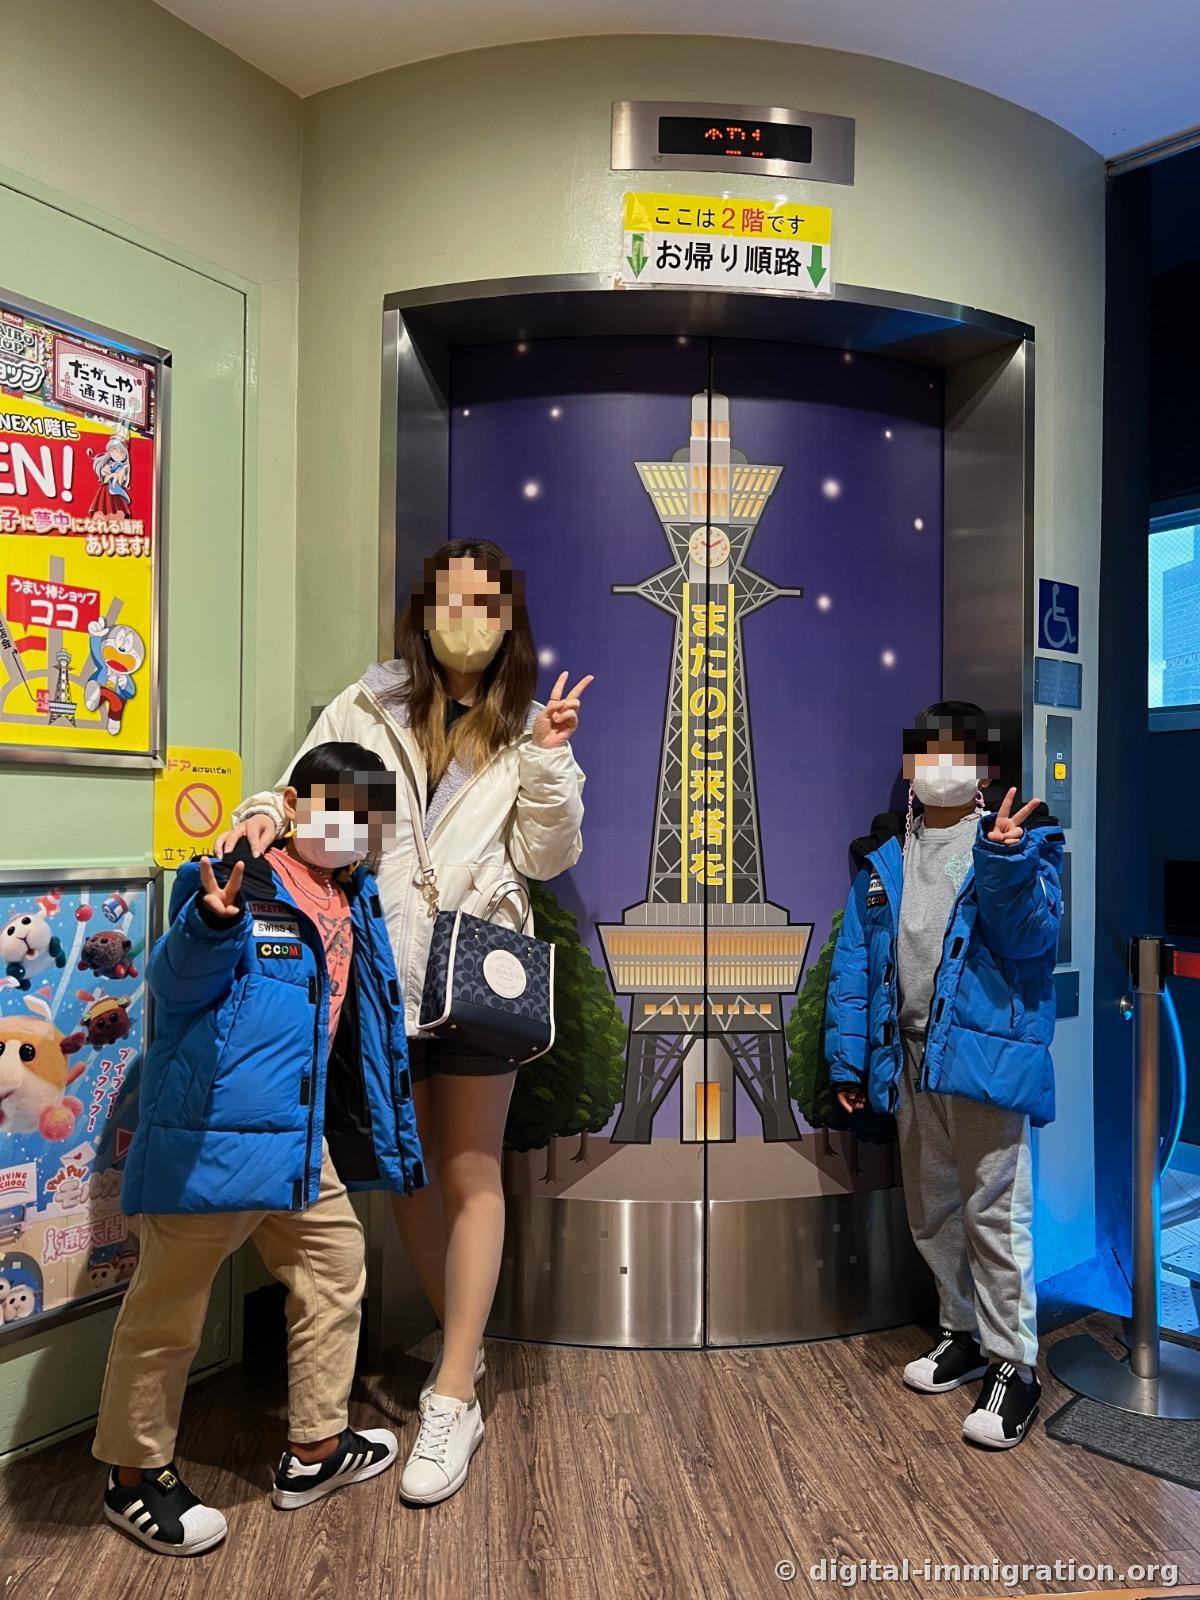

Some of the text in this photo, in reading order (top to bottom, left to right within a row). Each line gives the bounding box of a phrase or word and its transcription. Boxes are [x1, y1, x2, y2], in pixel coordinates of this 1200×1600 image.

[655, 207, 805, 235] ここは2階です
[656, 240, 802, 277] お帰り順路
[68, 359, 134, 393] だがしや
[79, 383, 125, 410] 通天閣
[86, 536, 150, 556] あります!
[11, 578, 97, 605] うまい棒ショップ
[31, 599, 79, 629] ココ
[689, 601, 727, 886] またのご来塔を
[167, 759, 191, 771] ドア
[258, 923, 286, 933] SWISS
[88, 1061, 111, 1131] ワクワク!
[107, 1048, 132, 1118] プイプイ!
[0, 1171, 27, 1182] IVING
